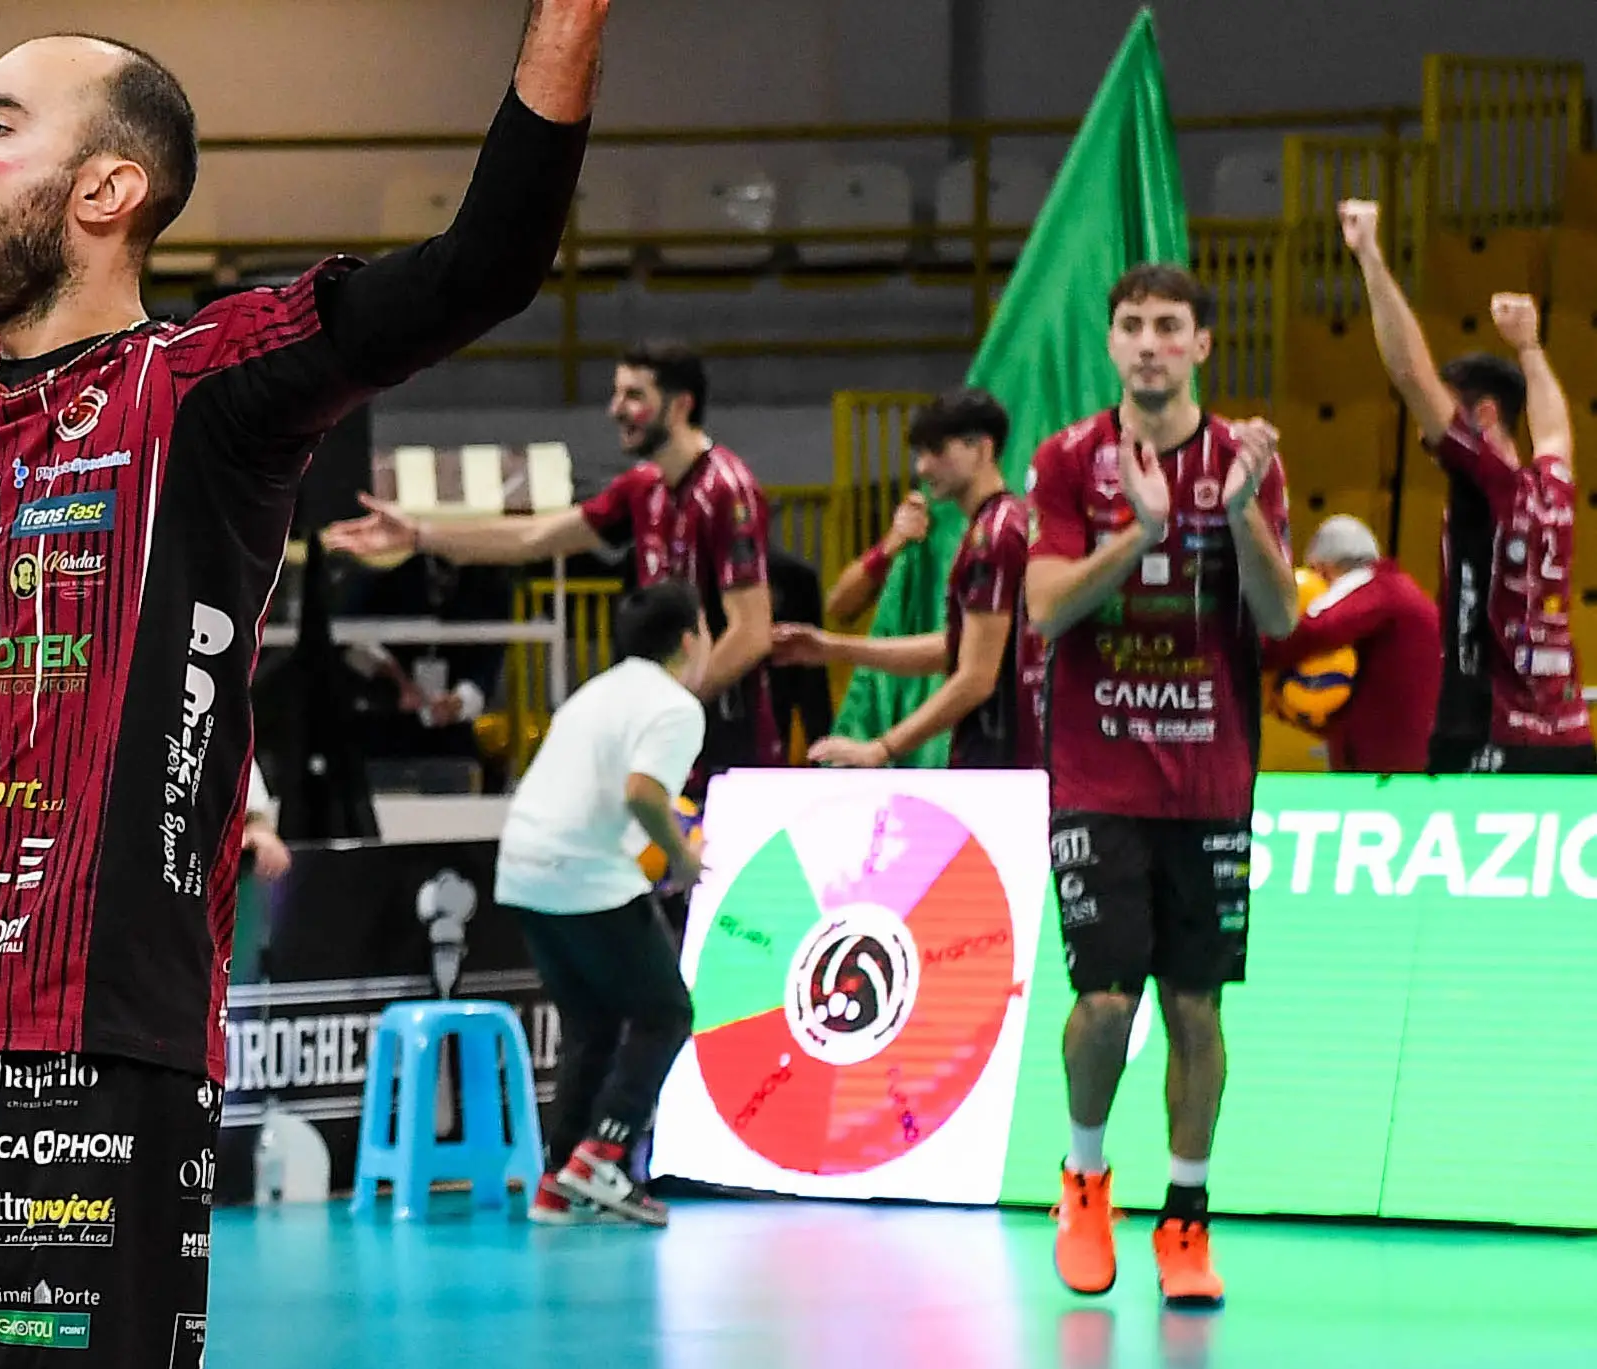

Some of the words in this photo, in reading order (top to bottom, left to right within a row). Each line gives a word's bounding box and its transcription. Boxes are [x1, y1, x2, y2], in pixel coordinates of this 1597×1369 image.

[1094, 679, 1214, 710] CANALE
[55, 1132, 135, 1160] PHONE
[54, 1287, 101, 1305] Porte
